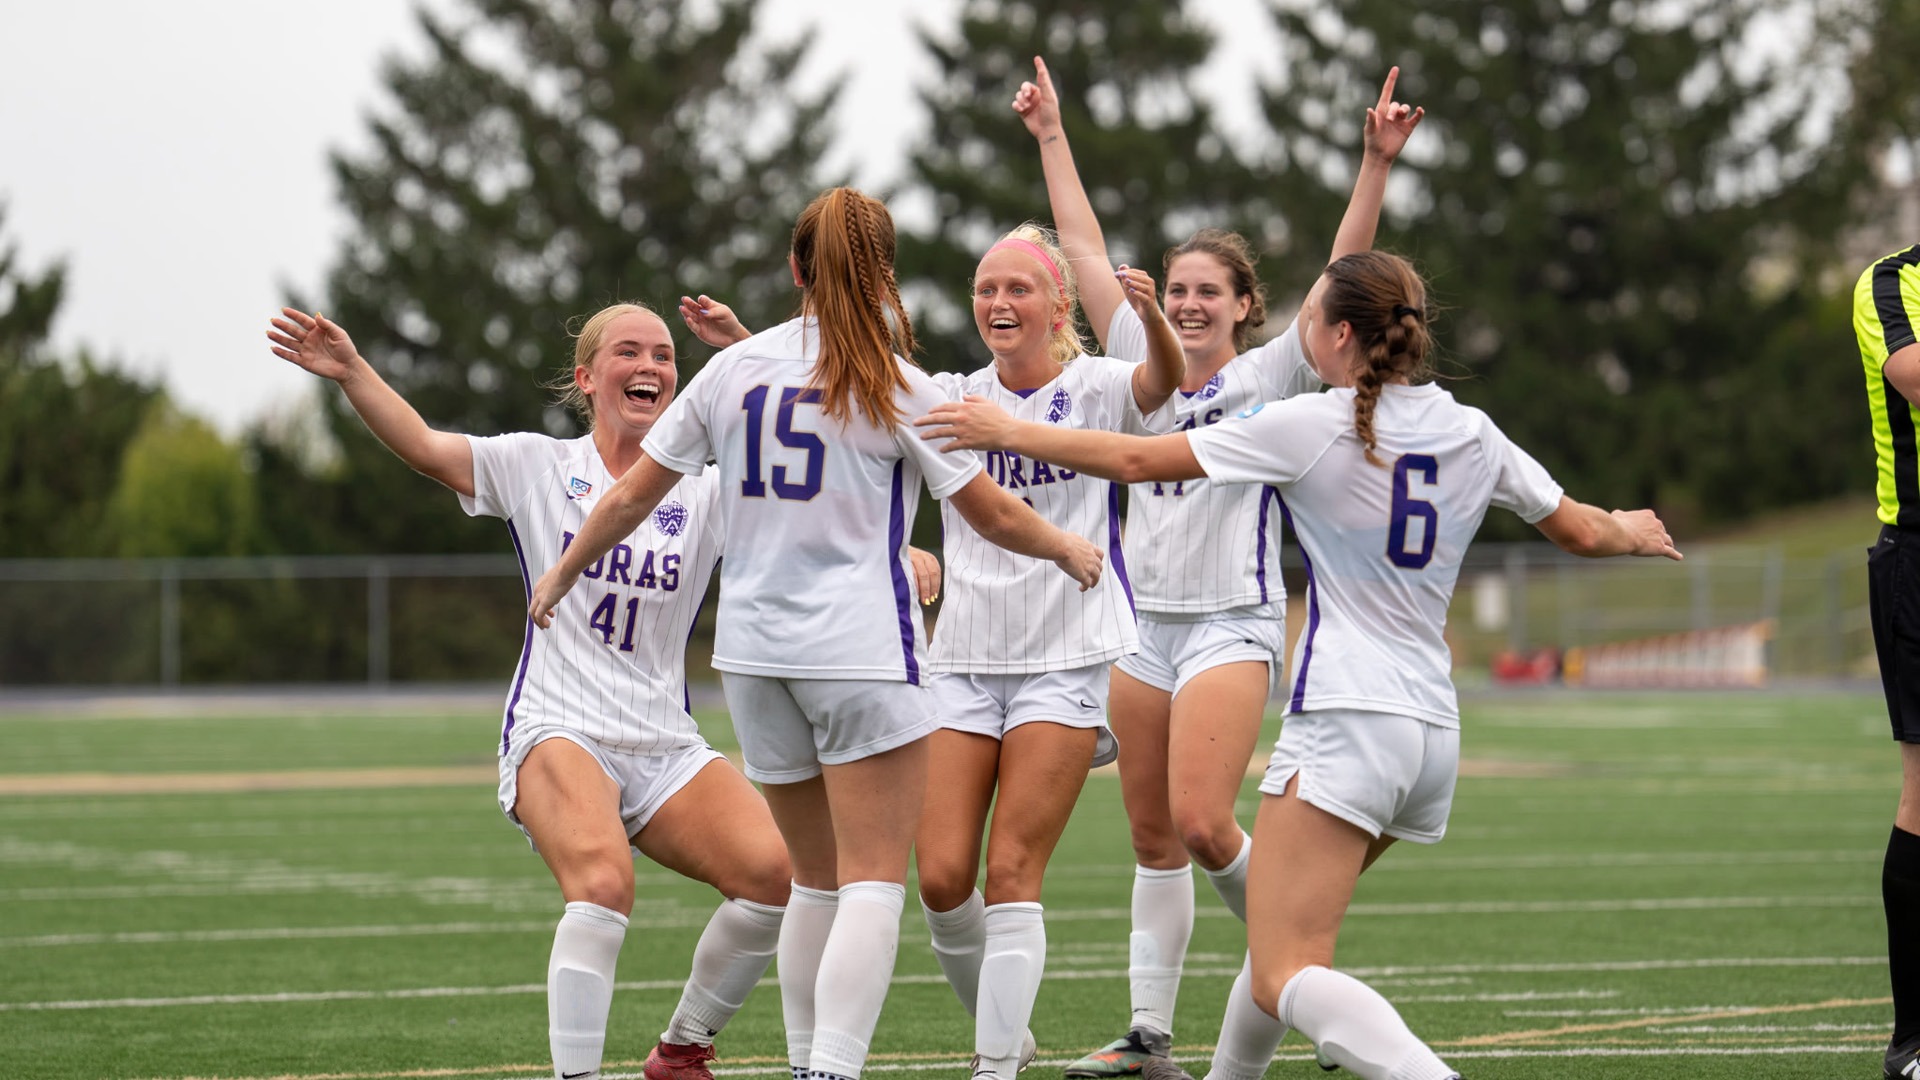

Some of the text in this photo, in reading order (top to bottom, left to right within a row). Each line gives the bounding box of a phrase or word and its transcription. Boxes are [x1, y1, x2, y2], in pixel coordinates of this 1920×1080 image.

[741, 384, 826, 501] 15
[986, 450, 1077, 489] ORA
[1386, 453, 1439, 570] 6
[590, 592, 640, 652] 41
